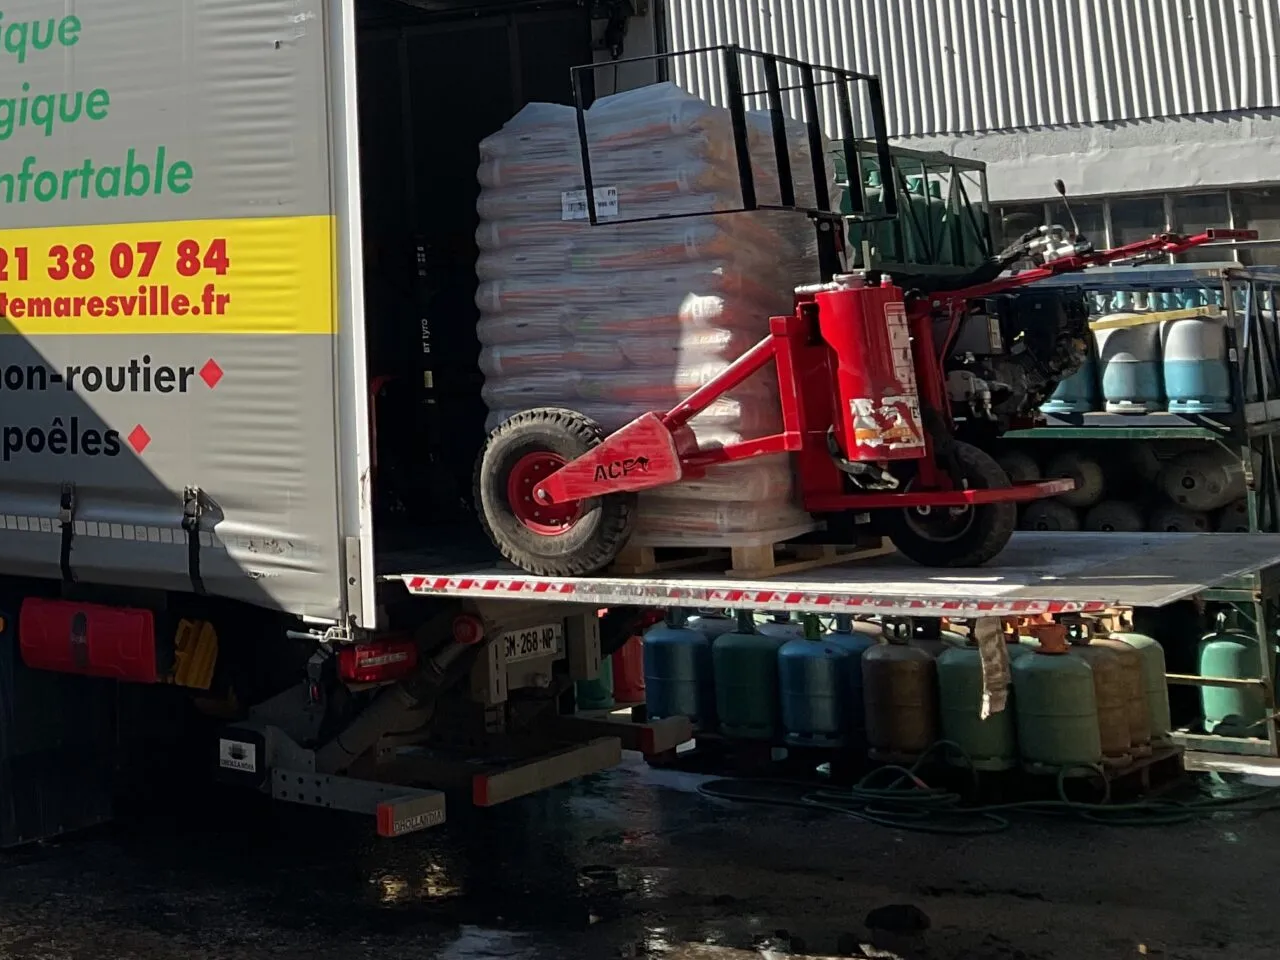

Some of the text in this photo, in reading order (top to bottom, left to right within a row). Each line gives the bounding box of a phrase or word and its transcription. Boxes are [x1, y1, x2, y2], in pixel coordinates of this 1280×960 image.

[48, 243, 95, 280] 38
[110, 241, 162, 278] 07
[176, 238, 230, 276] 84
[3, 416, 120, 461] poêles
[393, 810, 443, 832] DHOLLANDIA
